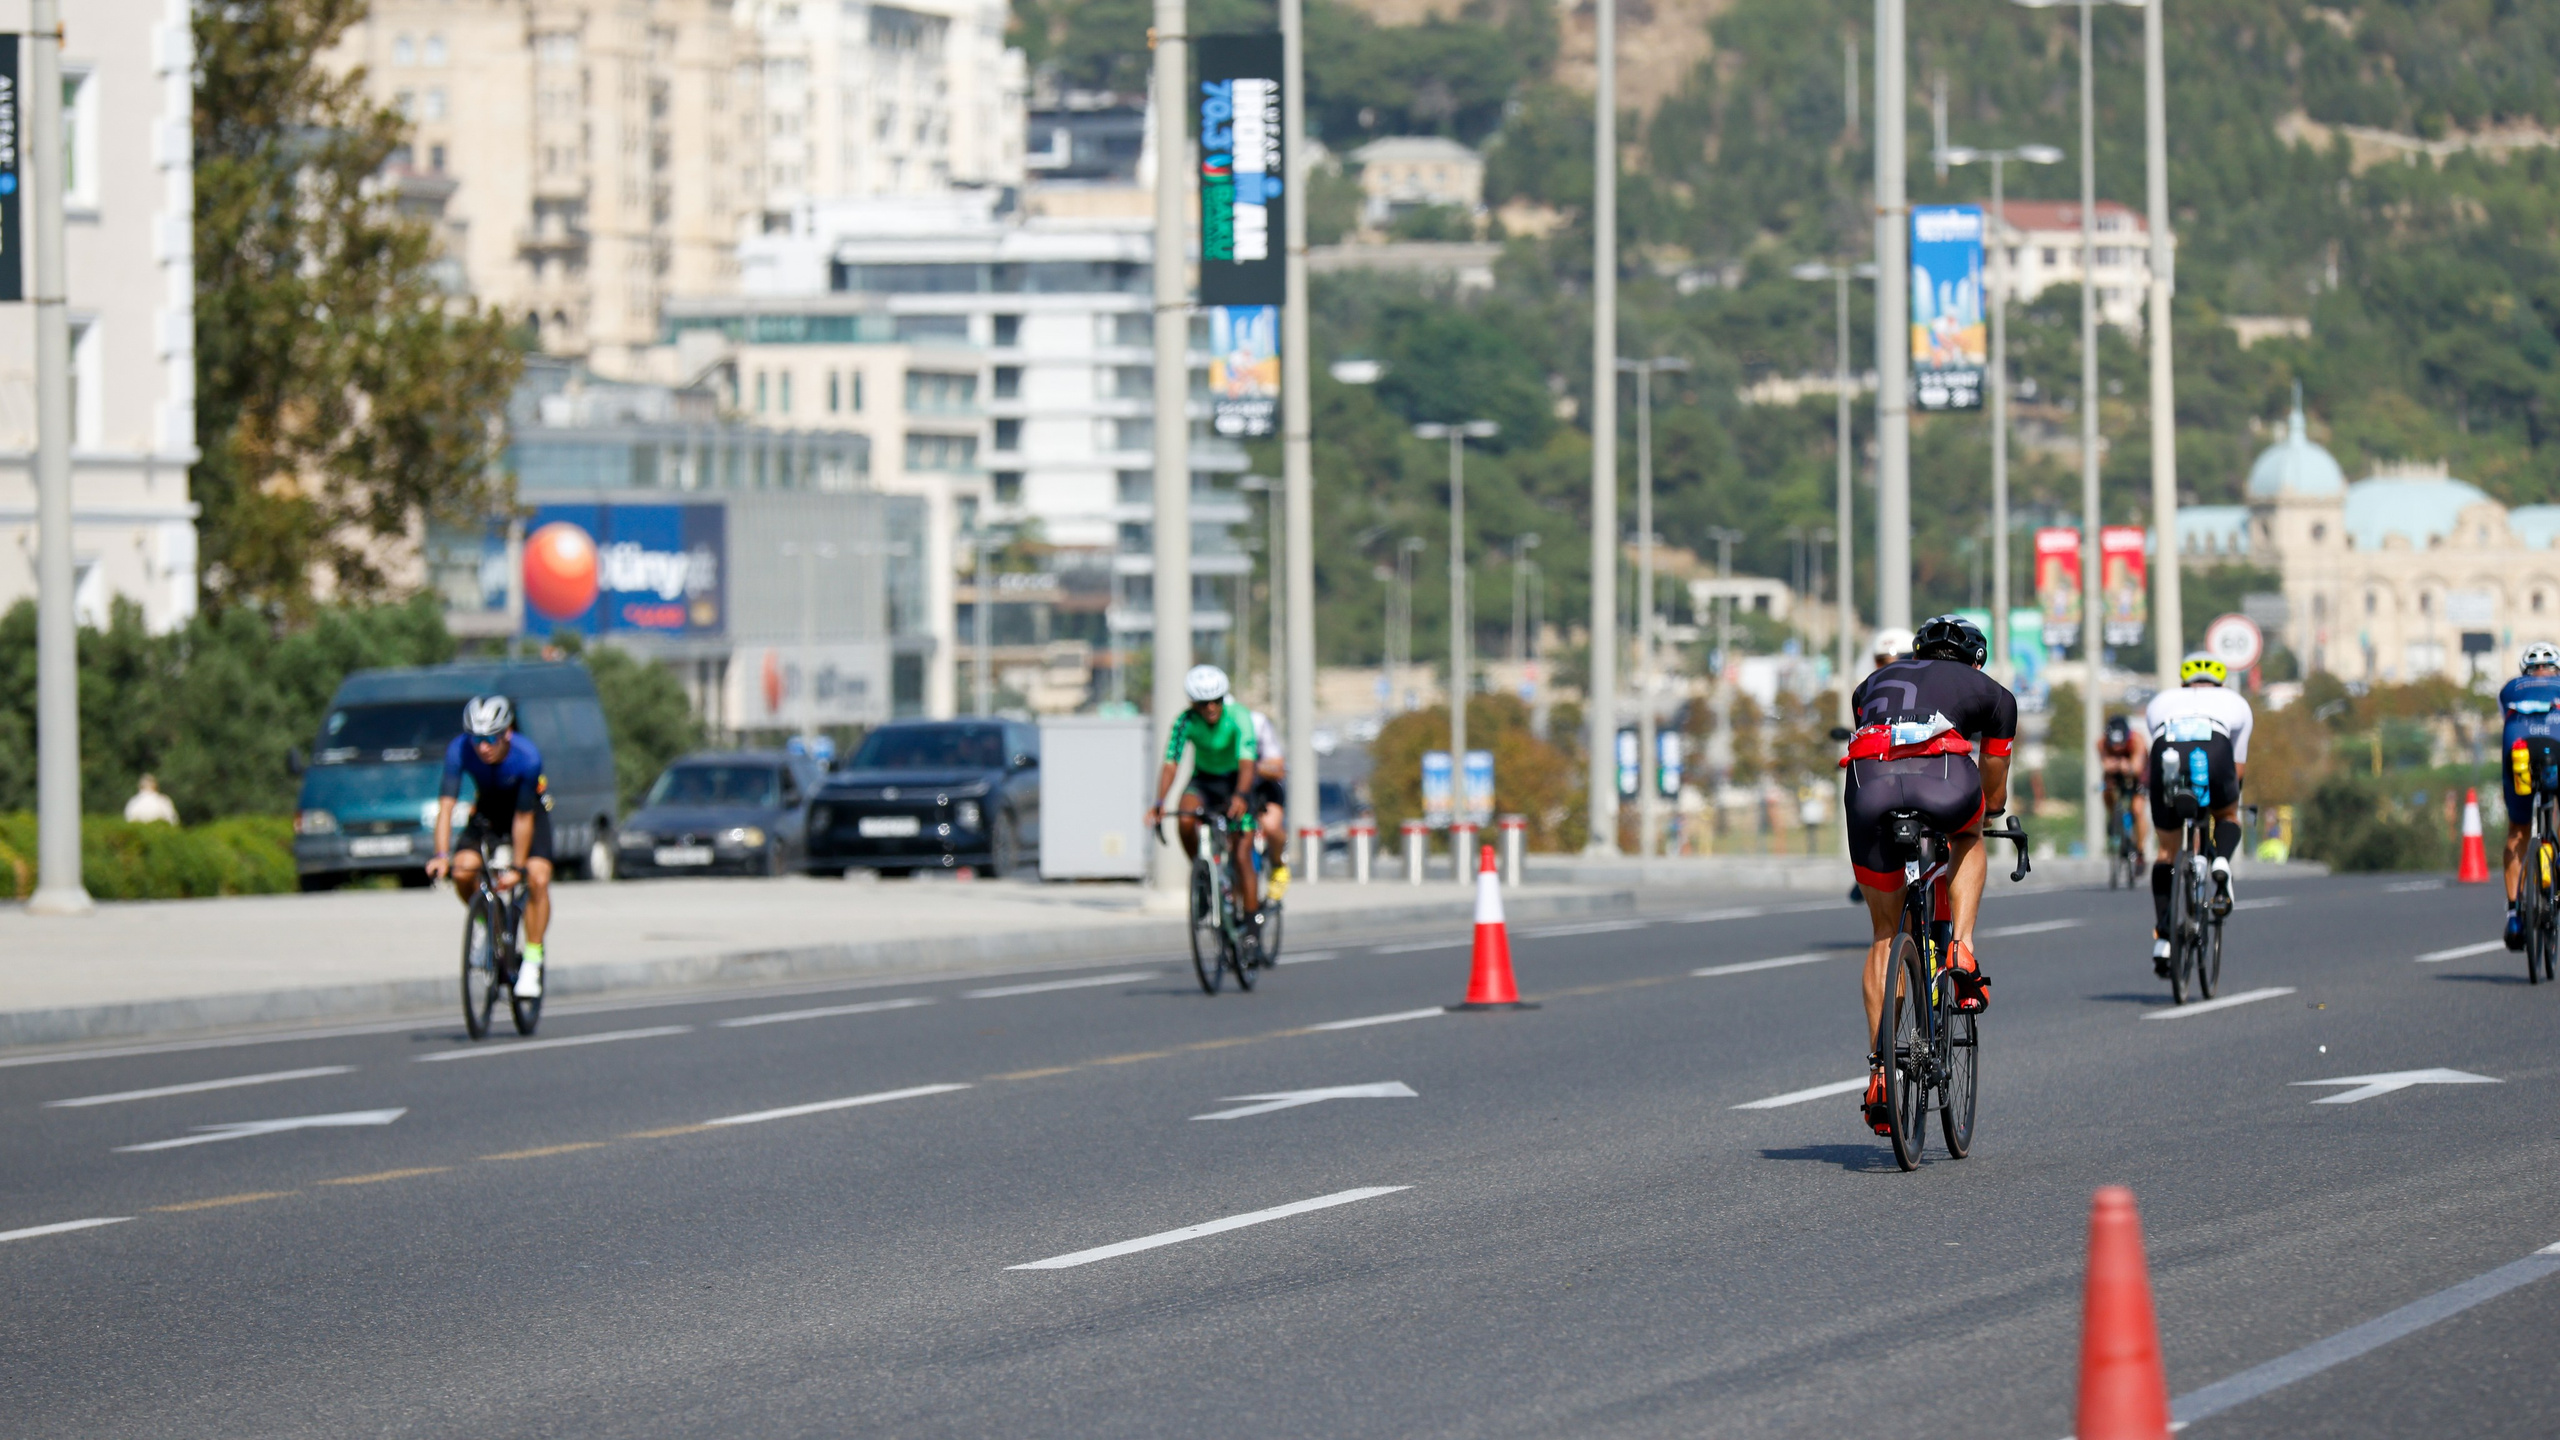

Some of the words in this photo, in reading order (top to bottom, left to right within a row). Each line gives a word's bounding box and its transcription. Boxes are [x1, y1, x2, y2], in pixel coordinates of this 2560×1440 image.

[1201, 78, 1233, 150] 70.3
[1232, 77, 1269, 261] IRONMAN
[2529, 723, 2550, 736] GRE
